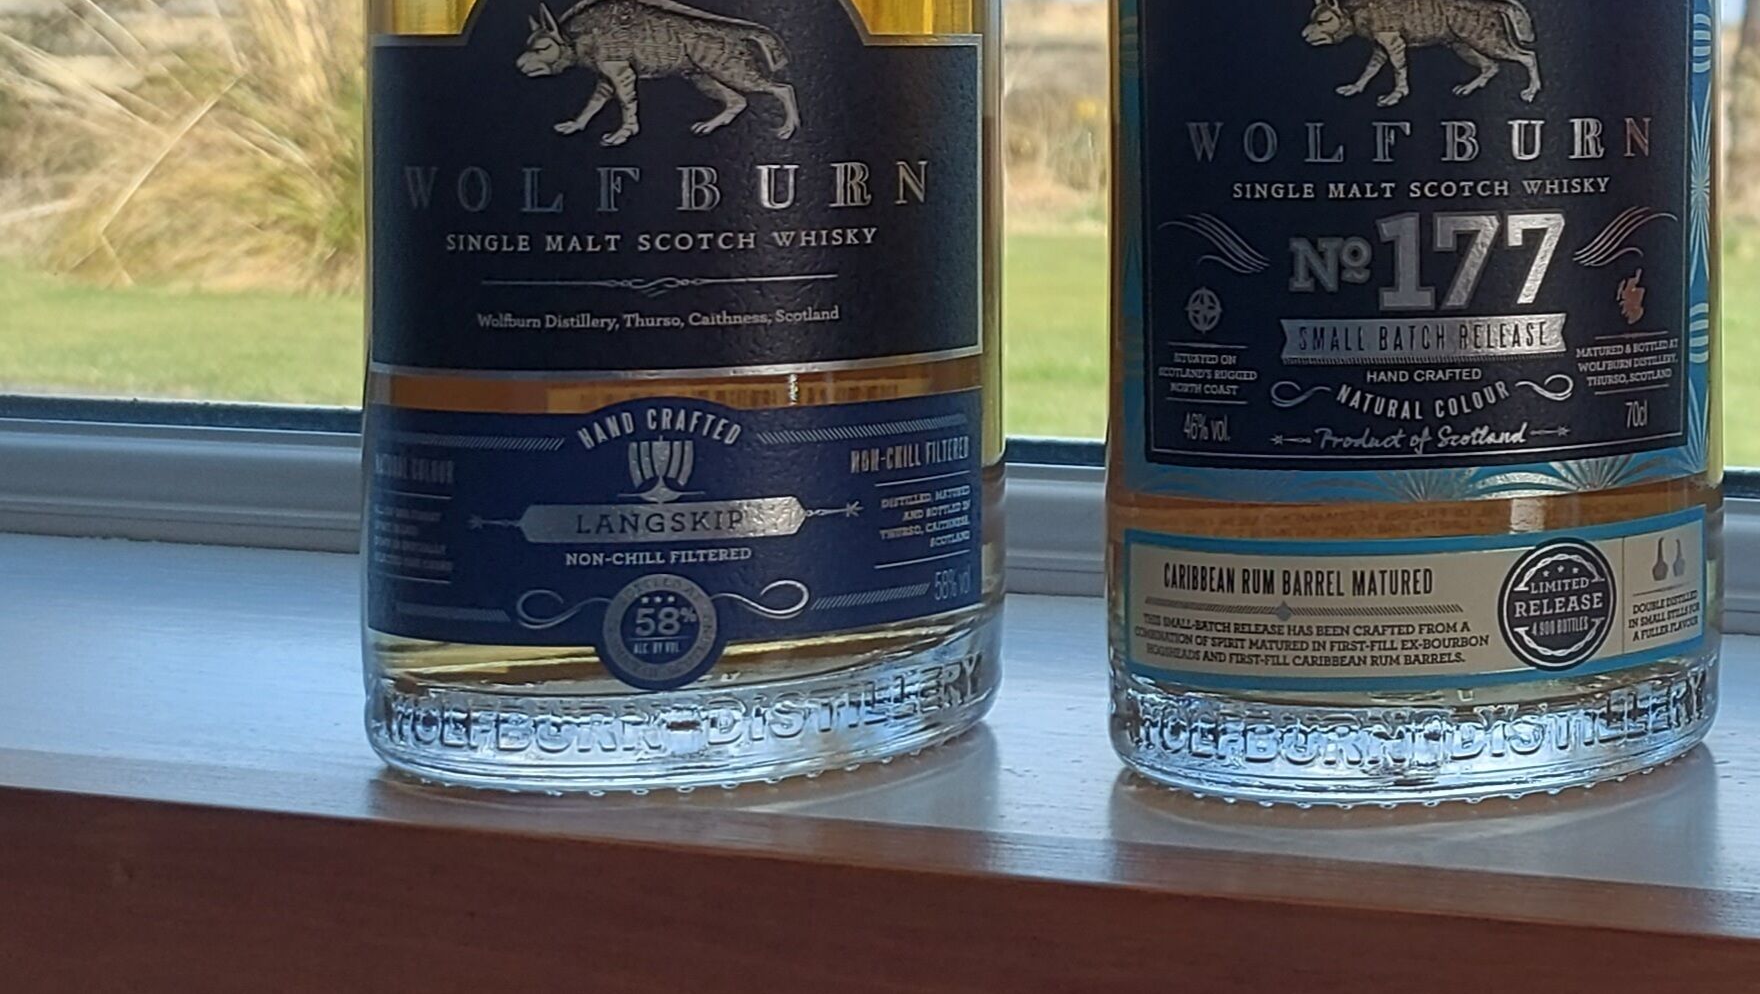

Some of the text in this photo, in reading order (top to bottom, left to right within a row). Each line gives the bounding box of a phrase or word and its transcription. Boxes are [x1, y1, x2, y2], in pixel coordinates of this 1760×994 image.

[1185, 116, 1653, 164] WOLFBURN
[403, 160, 930, 213] WOLFBURN
[1232, 176, 1611, 199] SINGLE MALT SCOTCH WHISKY
[446, 226, 878, 253] SINGLE MALT SCOTCH WHISKY
[1374, 209, 1566, 311] 177
[476, 305, 840, 333] Wolfburn Distillery, Thurso, Caithness, Scotland
[1299, 320, 1548, 351] SMALL BATCH RELEASE
[1575, 344, 1624, 358] MATURED
[1633, 339, 1669, 354] BOTTLED
[1366, 368, 1482, 383] HAND CRAFTED
[1203, 384, 1240, 396] COAST
[1335, 380, 1511, 421] NATURAL COLOUR
[1625, 399, 1648, 429] 70cl
[576, 407, 743, 450] HAND CRAFTED
[1314, 421, 1529, 455] Product of Scotland
[925, 435, 970, 465] FILTERED
[576, 509, 745, 535] LANGSKIP
[565, 547, 752, 567] NON-CHILL FILTERED
[1163, 561, 1433, 598] CARIBBEAN RUM BARREL MATURED
[1529, 576, 1590, 595] LIMITED
[1513, 592, 1604, 619] RELEASE
[1628, 617, 1639, 629] IN
[1640, 611, 1665, 627] SMALL
[1667, 606, 1688, 622] STILLS
[1632, 598, 1665, 615] DOUBLE
[634, 606, 697, 637] 58%
[1233, 622, 1285, 636] RELEASE
[1287, 624, 1313, 637] HAS
[1315, 624, 1350, 637] BEEN
[1352, 623, 1412, 637] CRAFTED
[1414, 621, 1459, 635] FROM
[1460, 621, 1471, 633] A
[1632, 629, 1640, 642] A
[1641, 622, 1670, 639] FULLER
[1194, 635, 1490, 653] OF SPIRIT MATURED IN FIRST-FILL EX-BOURBON
[1201, 650, 1466, 668] AND FIRST-FILL CARIBBEAN RUM BARRELS.
